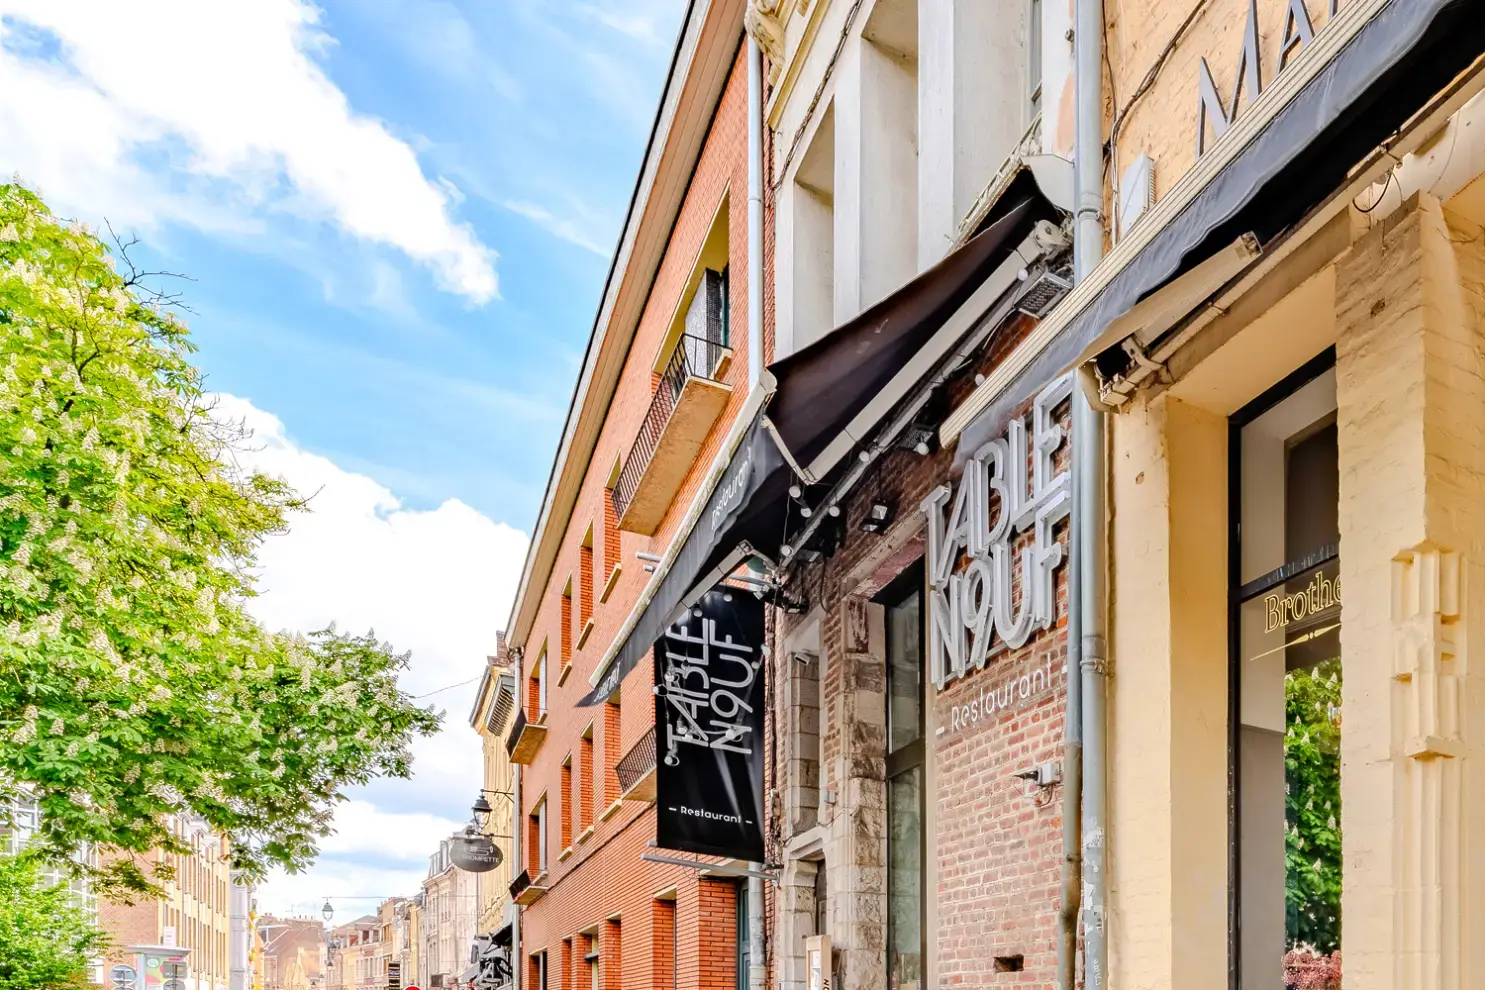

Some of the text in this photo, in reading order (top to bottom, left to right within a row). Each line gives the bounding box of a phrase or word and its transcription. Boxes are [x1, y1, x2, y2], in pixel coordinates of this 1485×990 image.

[1197, 0, 1338, 160] MA
[920, 371, 1072, 590] TABLE
[665, 618, 709, 750] TABLE
[951, 652, 1052, 734] Restaurant
[680, 805, 742, 824] Restaurant
